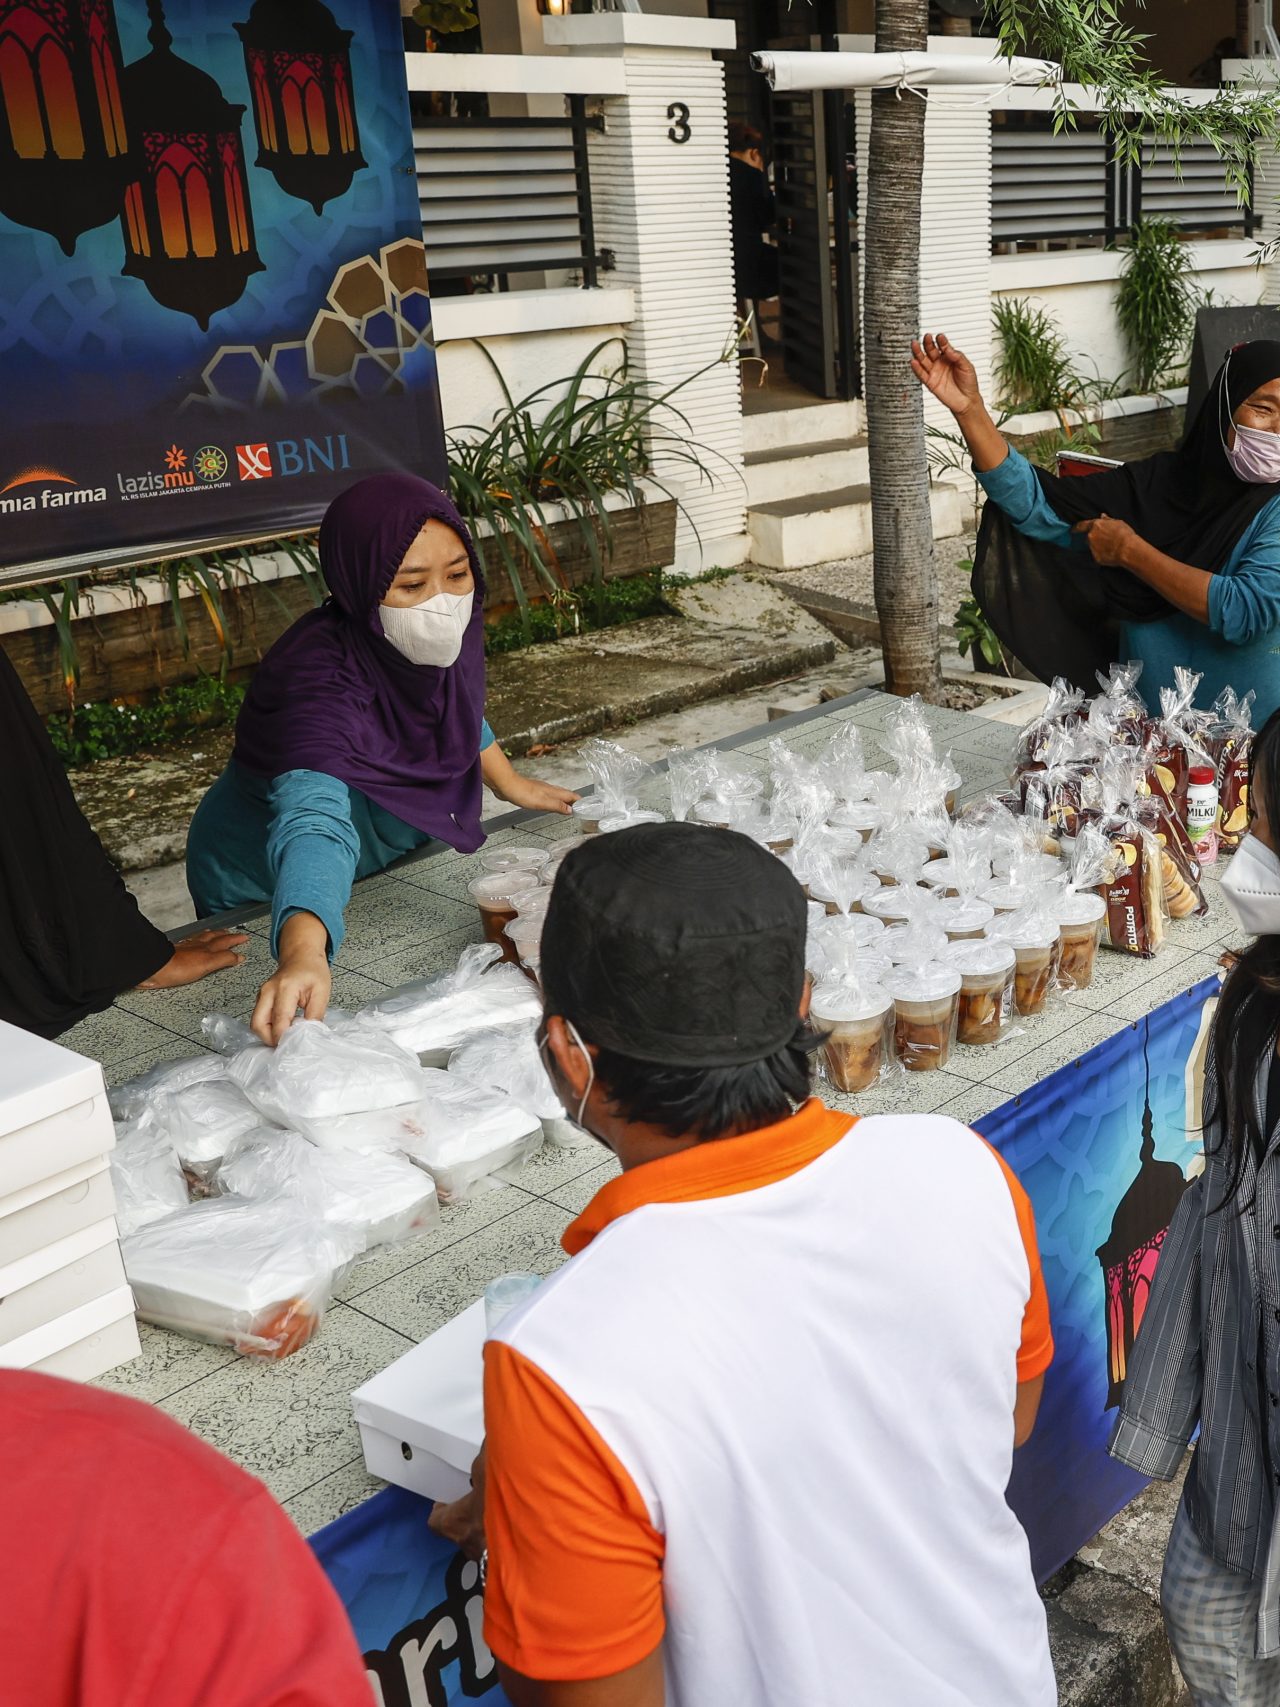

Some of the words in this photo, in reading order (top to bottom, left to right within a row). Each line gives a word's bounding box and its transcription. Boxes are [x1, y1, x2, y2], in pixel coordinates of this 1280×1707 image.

[667, 102, 692, 144] 3
[276, 434, 351, 476] BNI
[117, 471, 195, 494] lazismu
[130, 492, 139, 500] RS
[140, 490, 159, 499] ISLAM
[158, 487, 186, 497] JAKARTA
[185, 483, 214, 493] CEMPAKA
[213, 481, 232, 489] PUTIH
[41, 488, 107, 509] farma
[1187, 806, 1216, 817] MILKU
